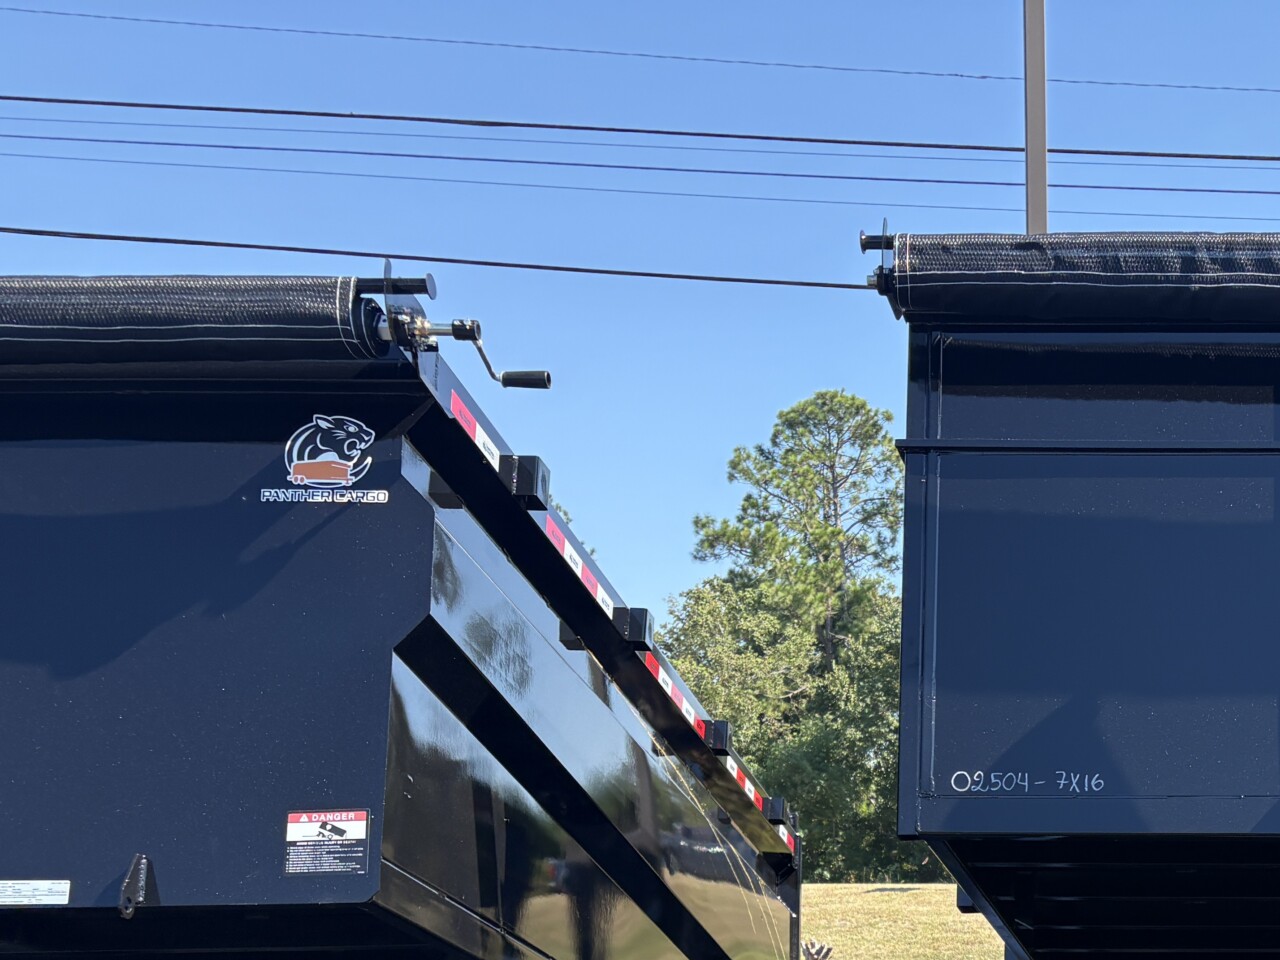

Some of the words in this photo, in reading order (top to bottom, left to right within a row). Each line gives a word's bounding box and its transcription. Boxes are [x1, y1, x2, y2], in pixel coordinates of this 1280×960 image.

[261, 488, 332, 502] PANTHER
[333, 489, 389, 503] CARGO
[950, 770, 1029, 793] 02504
[311, 812, 356, 821] DANGER
